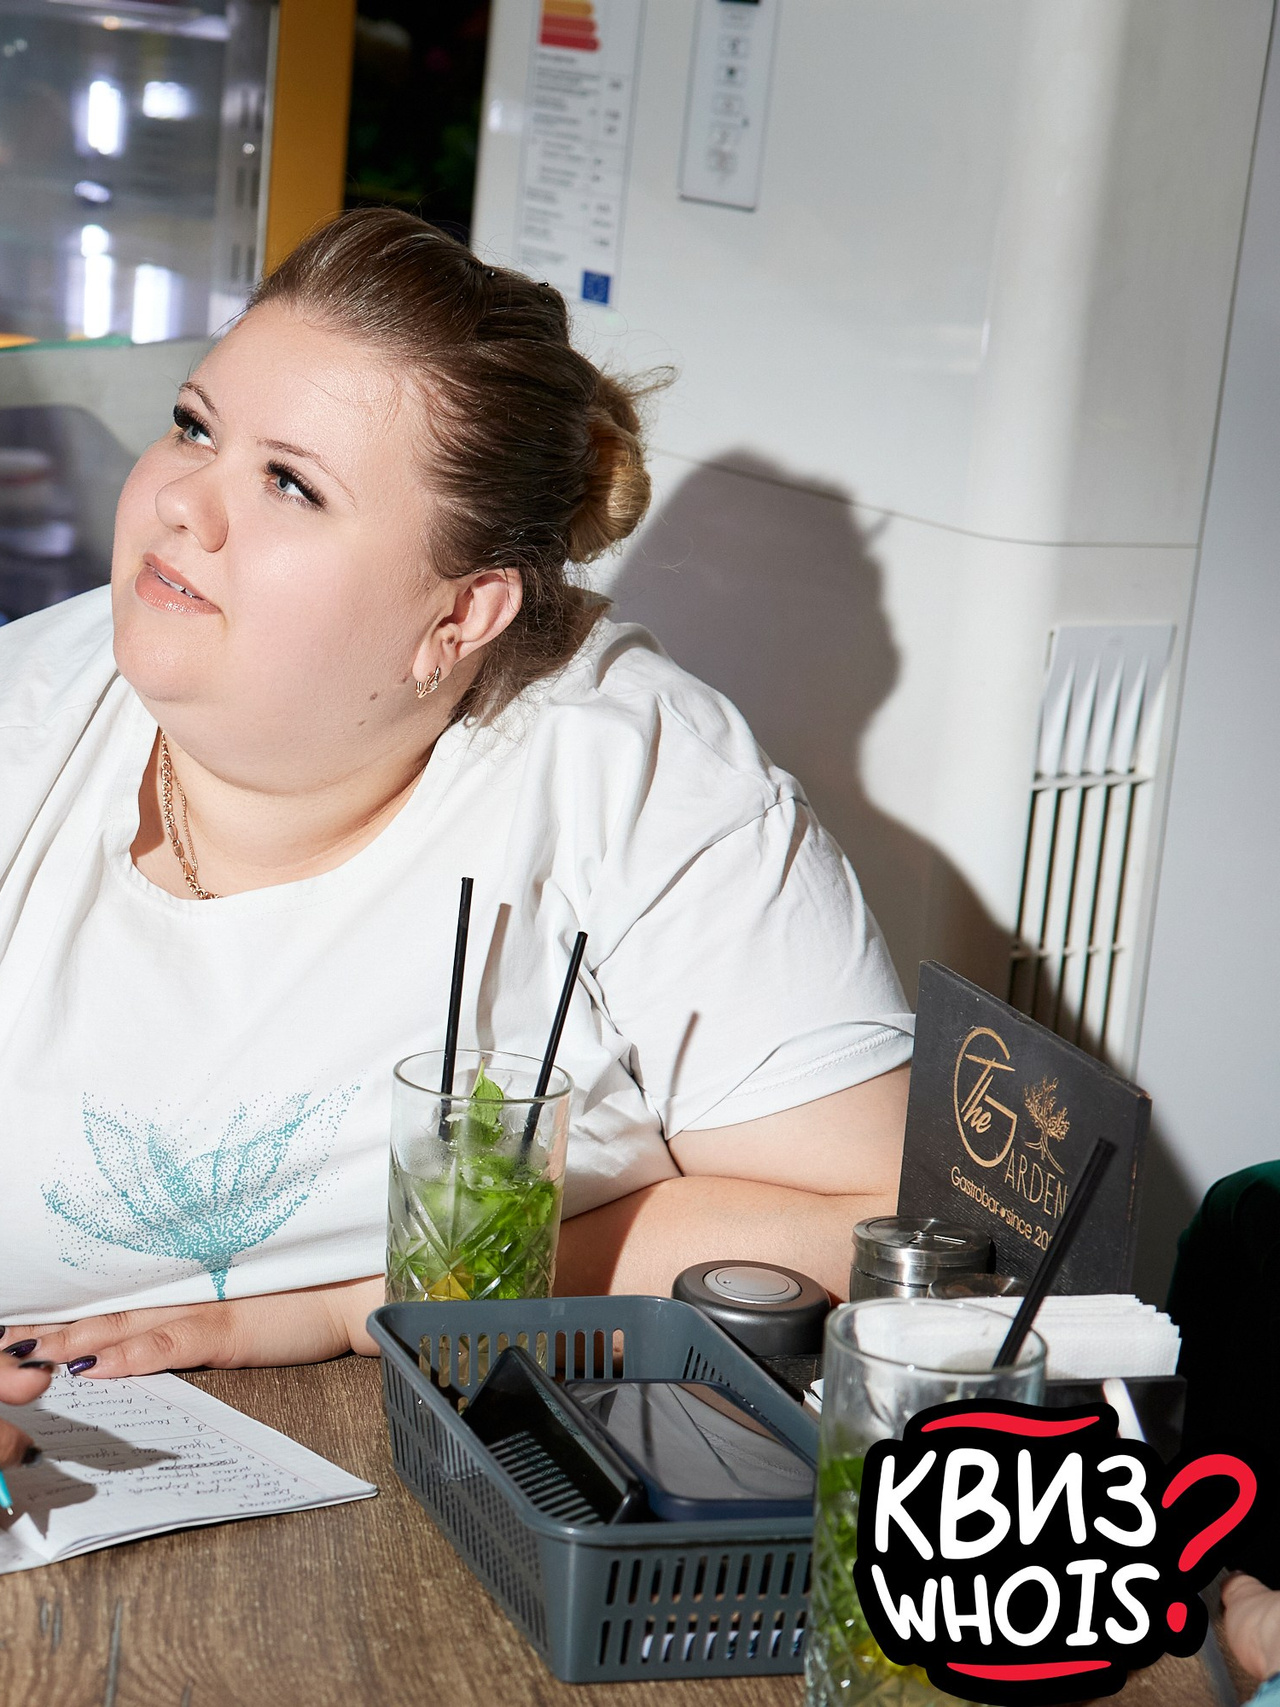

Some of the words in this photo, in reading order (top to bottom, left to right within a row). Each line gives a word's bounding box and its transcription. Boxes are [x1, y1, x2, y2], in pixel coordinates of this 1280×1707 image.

[960, 1052, 1016, 1134] The
[1005, 1208, 1033, 1240] since
[1033, 1225, 1054, 1251] 20
